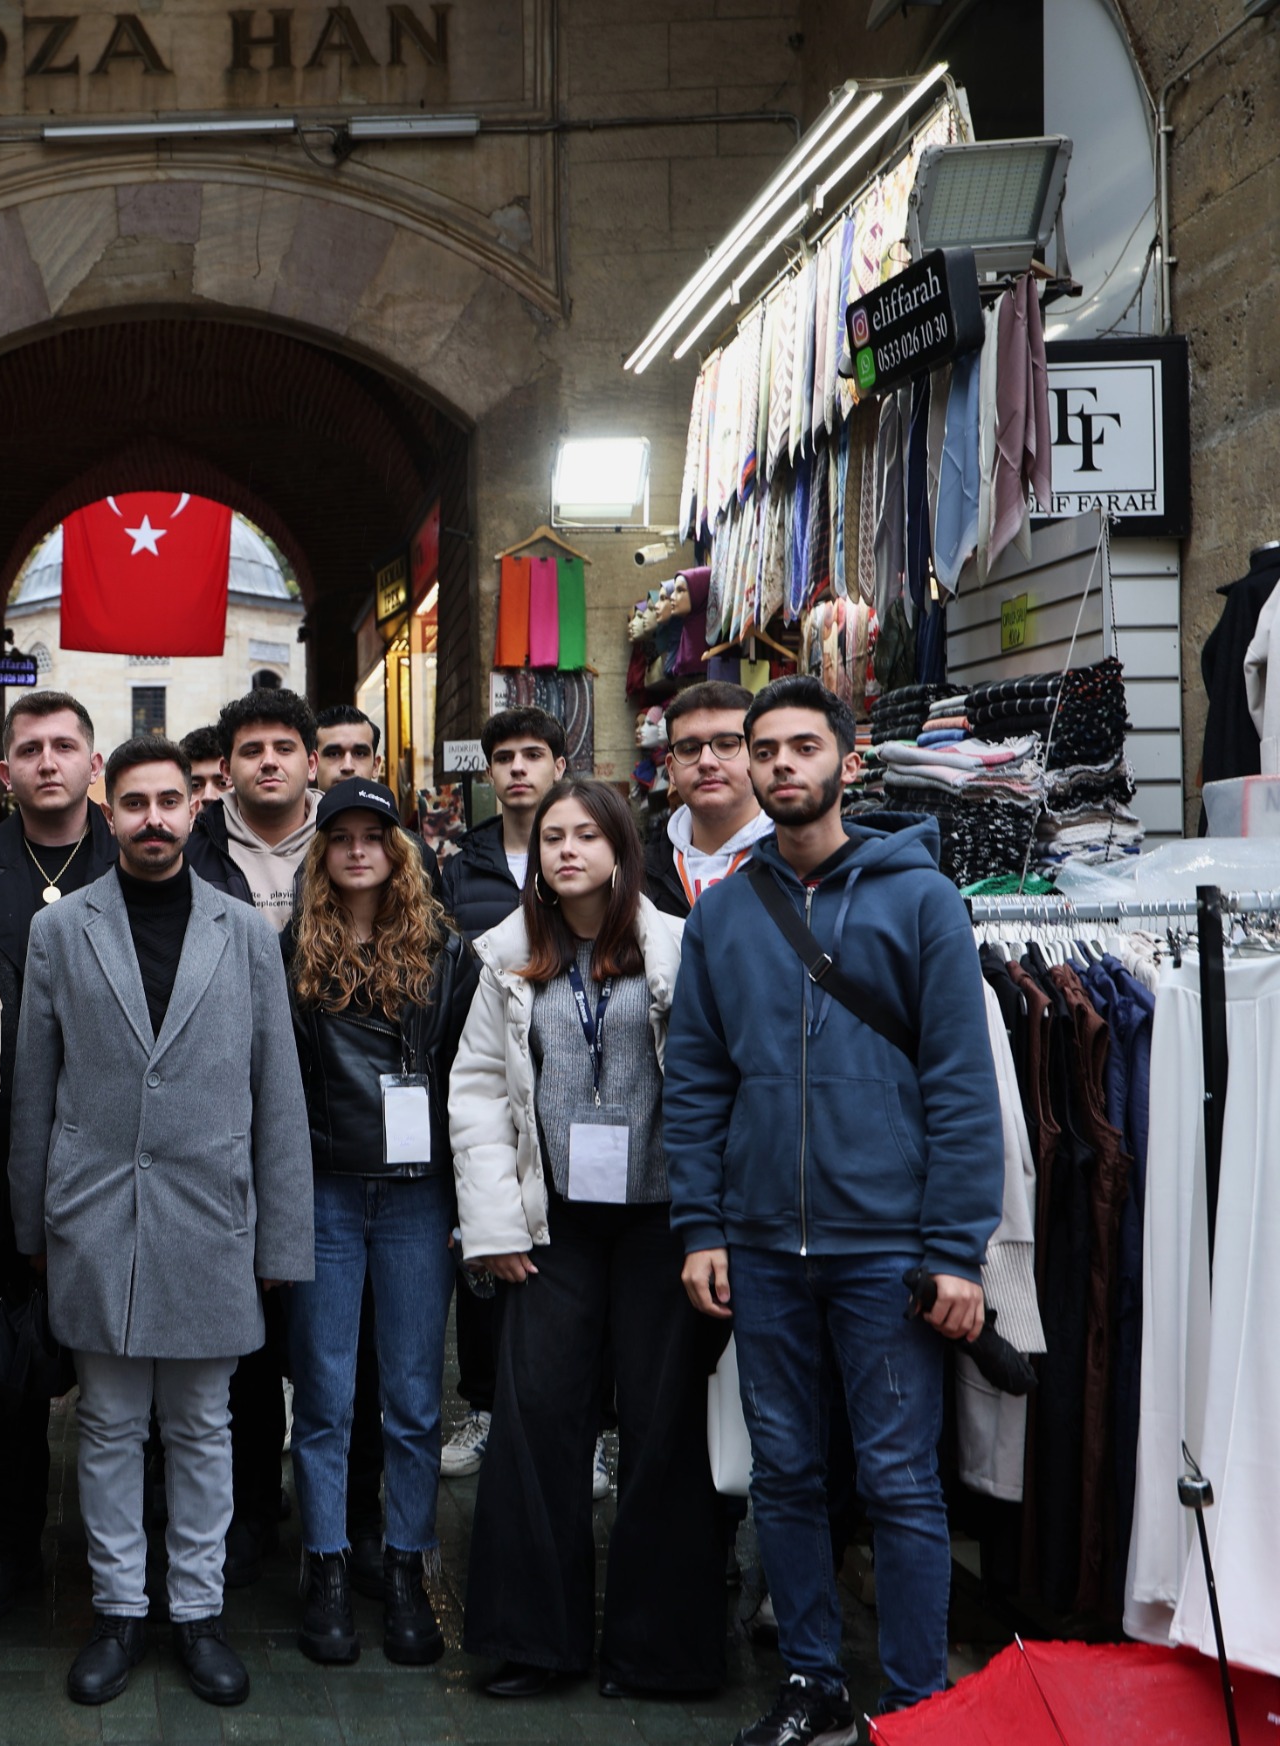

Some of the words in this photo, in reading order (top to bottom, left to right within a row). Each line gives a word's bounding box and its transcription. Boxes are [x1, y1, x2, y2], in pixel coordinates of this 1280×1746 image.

[227, 3, 453, 71] HAN
[872, 266, 942, 332] eliffarah
[877, 339, 901, 373] 0533
[901, 326, 920, 360] 026
[921, 320, 934, 349] 10
[934, 312, 948, 343] 30
[1077, 493, 1157, 513] FARAH
